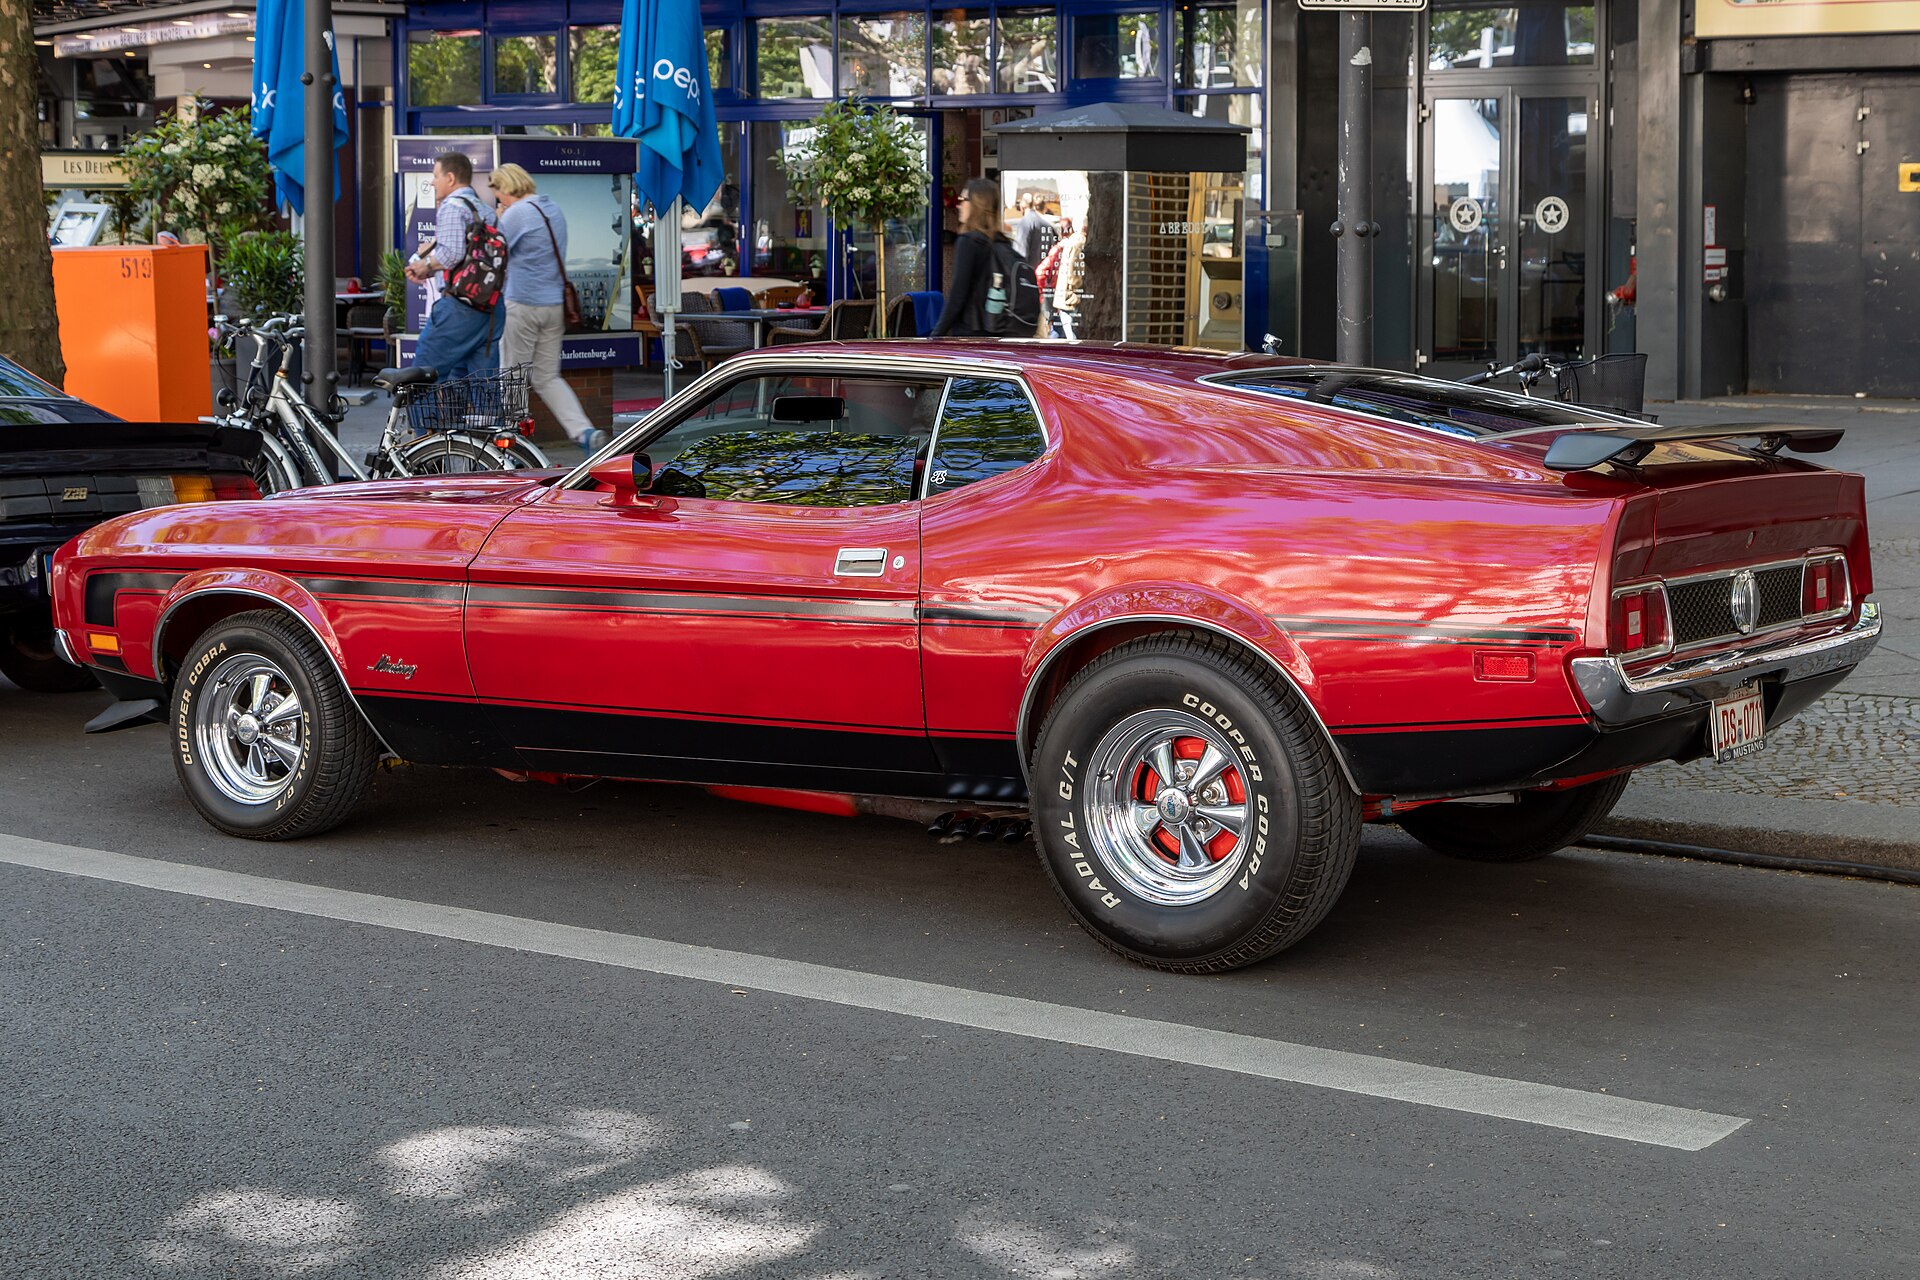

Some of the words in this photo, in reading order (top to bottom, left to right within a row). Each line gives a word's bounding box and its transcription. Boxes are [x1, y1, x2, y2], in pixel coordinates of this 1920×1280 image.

[63, 160, 82, 174] LES
[539, 159, 601, 167] CHARLOTTENBURG
[121, 257, 151, 279] 519
[63, 487, 88, 500] Z28
[366, 653, 418, 680] Mustang
[178, 688, 193, 766] COOPER
[188, 642, 228, 686] COBRA
[294, 711, 312, 781] RADIAL
[1733, 740, 1764, 758] MUSTANG
[1058, 750, 1078, 801] G/T
[275, 785, 295, 811] G/T
[1182, 692, 1264, 782] COOPER
[1238, 794, 1269, 892] COBRA
[1060, 811, 1122, 909] RADIAL
